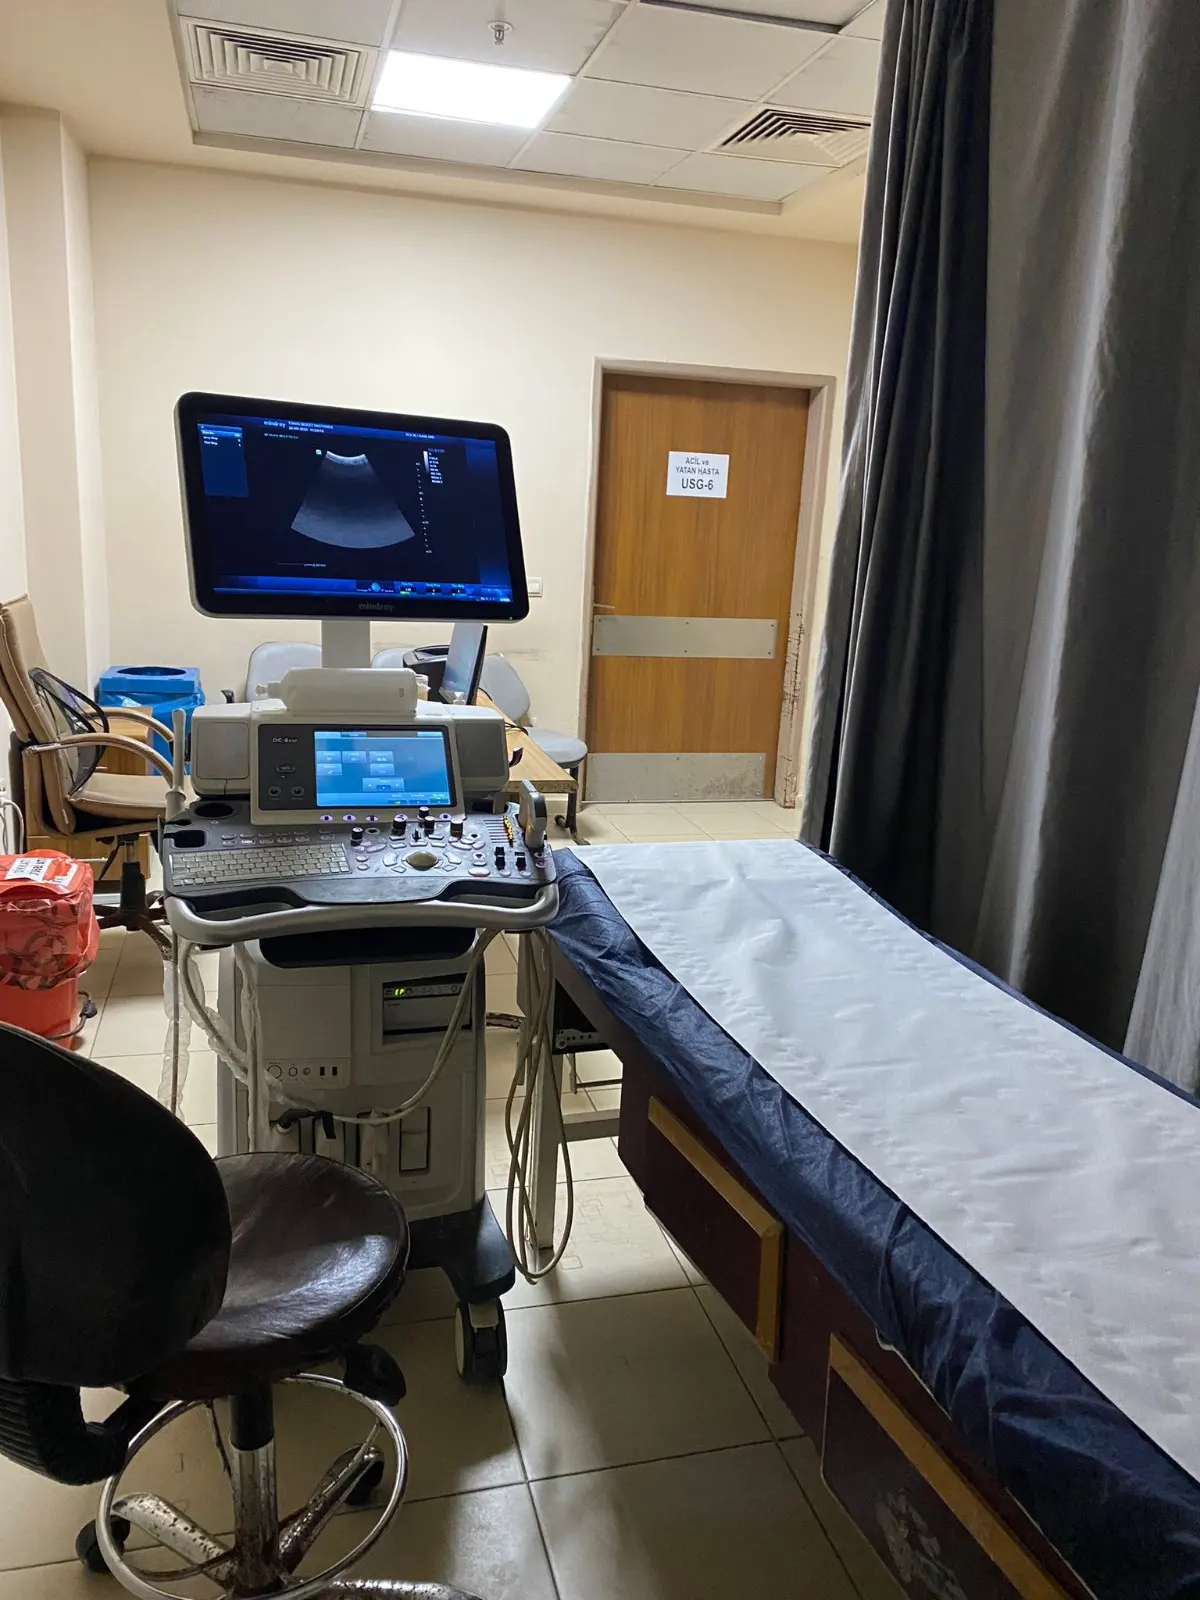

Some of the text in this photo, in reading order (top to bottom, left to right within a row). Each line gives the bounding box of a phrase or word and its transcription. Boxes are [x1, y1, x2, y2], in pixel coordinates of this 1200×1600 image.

[675, 466, 720, 475] YATAN HASTA
[681, 478, 714, 491] USG-6
